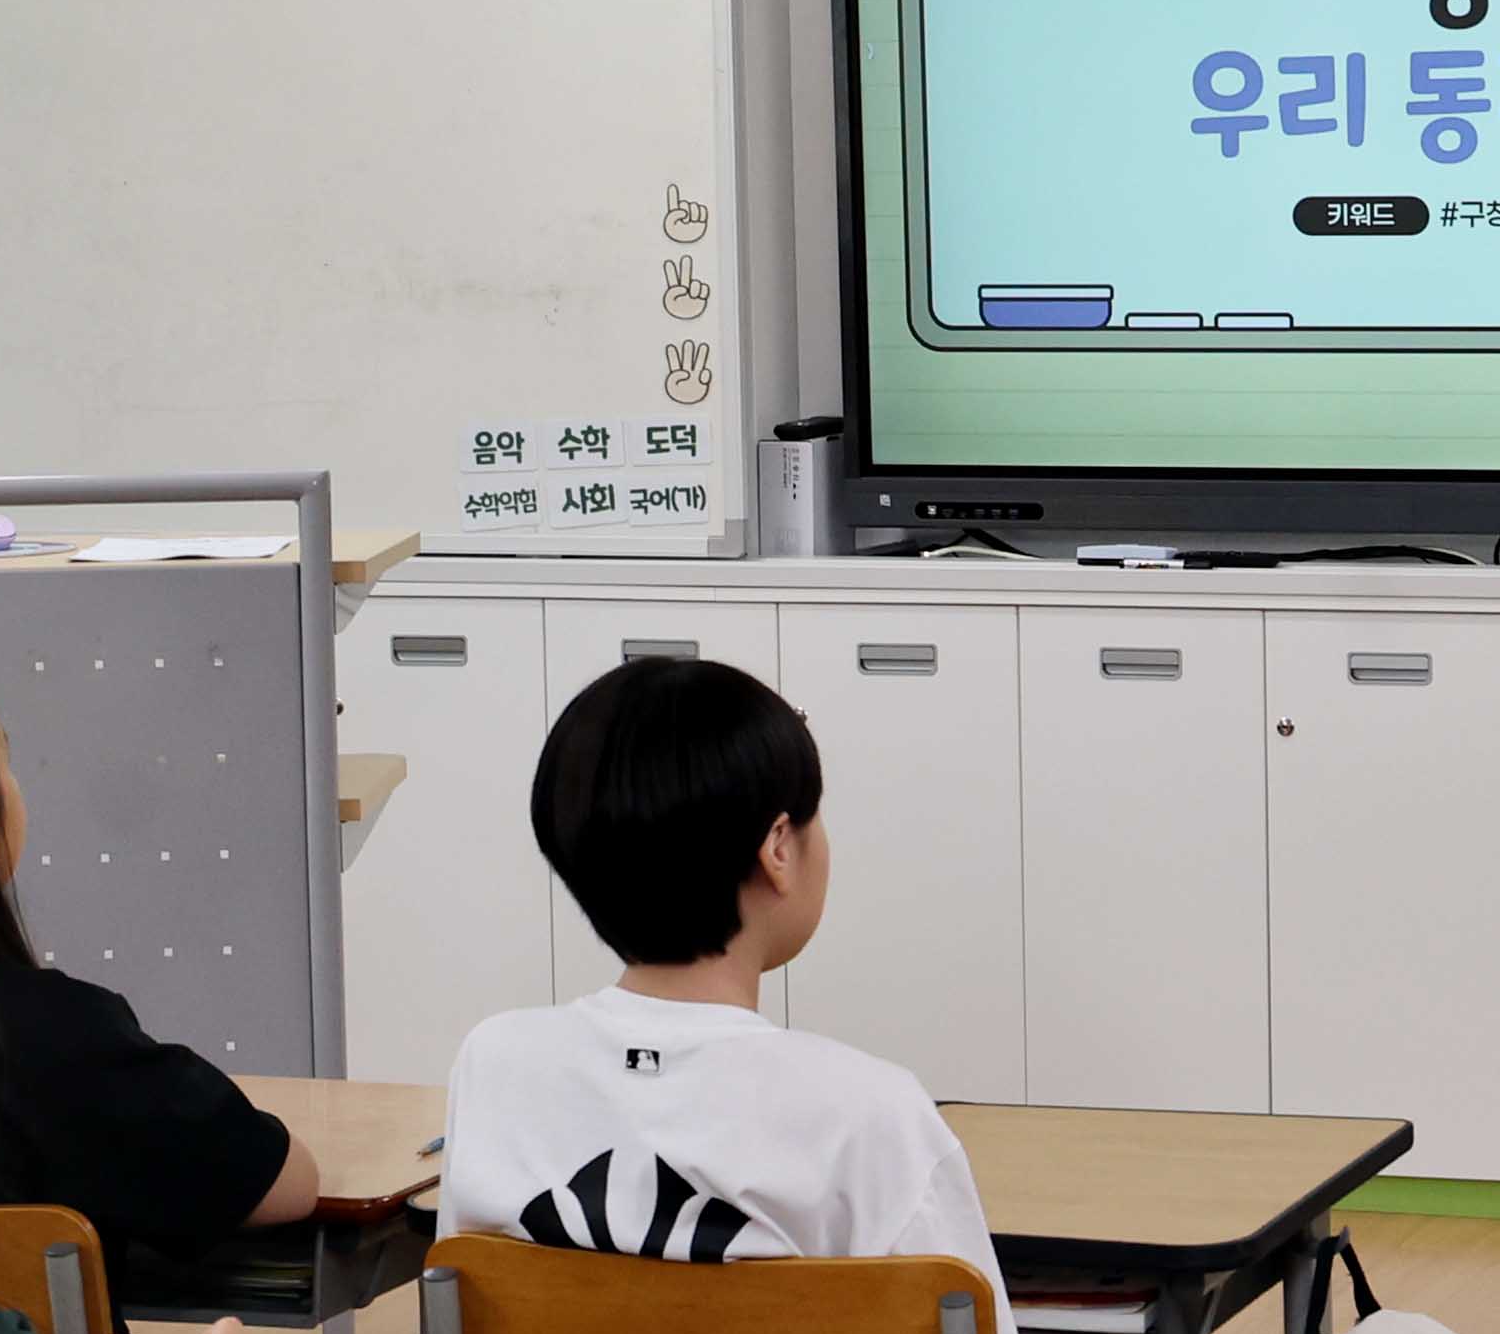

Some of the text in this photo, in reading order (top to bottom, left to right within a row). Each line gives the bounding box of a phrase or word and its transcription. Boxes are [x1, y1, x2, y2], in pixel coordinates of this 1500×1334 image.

[1190, 51, 1367, 158] 우리
[1327, 202, 1395, 227] 키워드
[472, 430, 525, 465] 음악
[558, 425, 611, 460] 수학
[646, 424, 698, 457] 도덕
[463, 488, 538, 518] 수학익힘
[561, 483, 616, 514] 사회
[629, 484, 706, 512] 국어(가)
